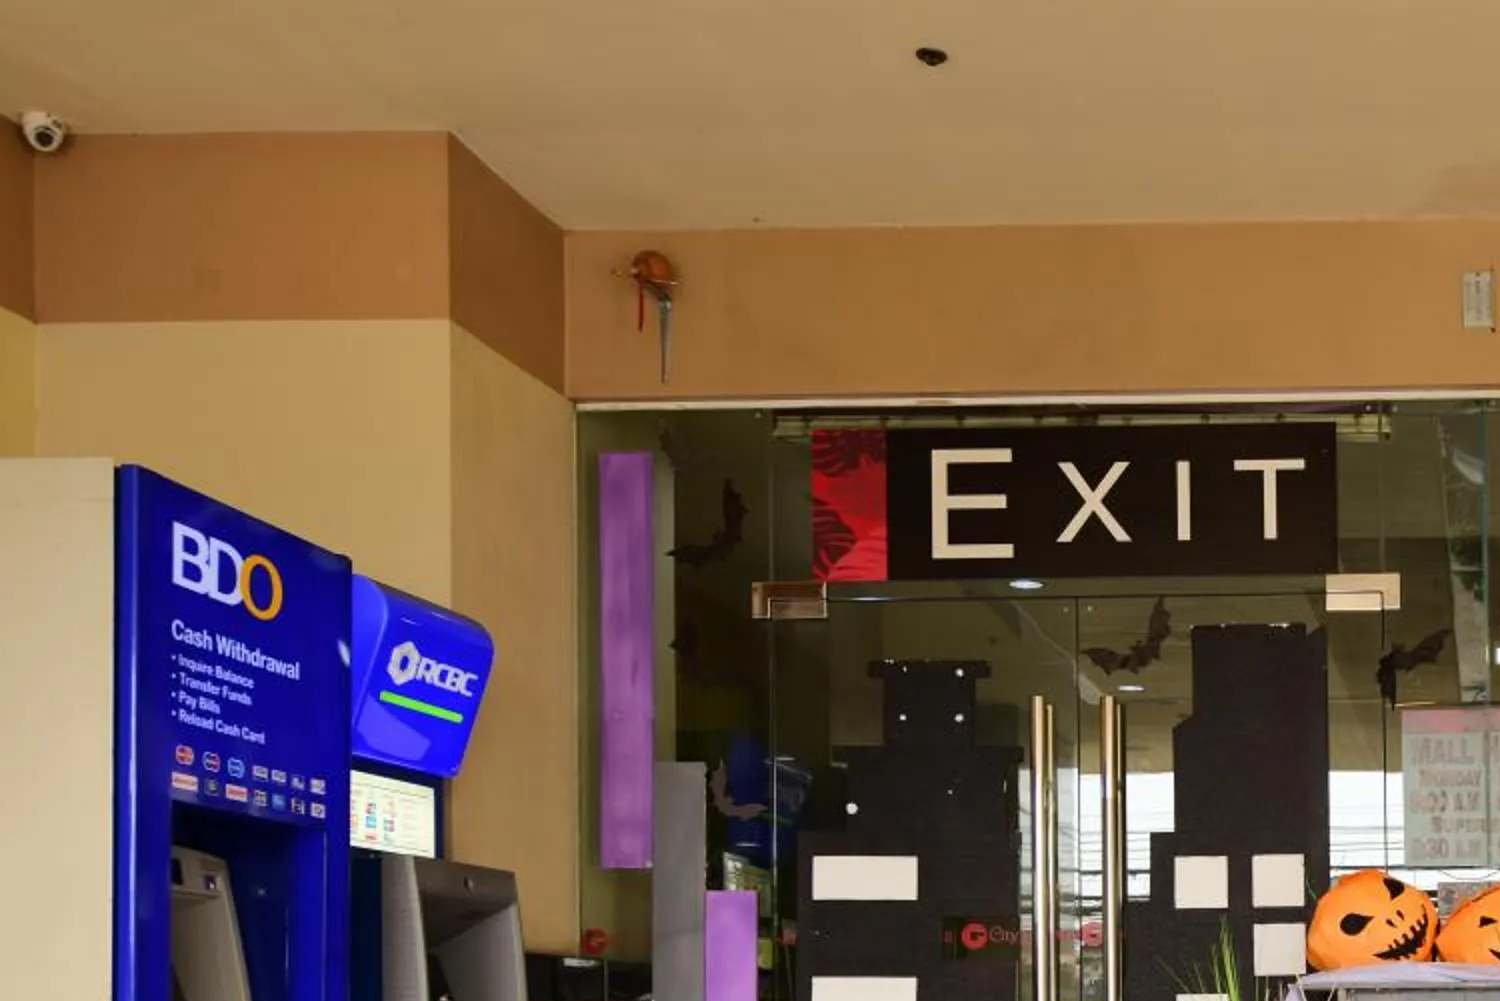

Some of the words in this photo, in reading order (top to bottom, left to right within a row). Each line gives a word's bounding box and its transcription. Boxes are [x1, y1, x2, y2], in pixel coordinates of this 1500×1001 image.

[931, 448, 1305, 560] EXIT
[172, 520, 283, 620] BDO
[171, 619, 213, 651] Cash
[215, 634, 300, 680] Withdrawal
[179, 690, 197, 710] Pay
[416, 656, 478, 696] RCBC
[215, 719, 240, 737] Cash
